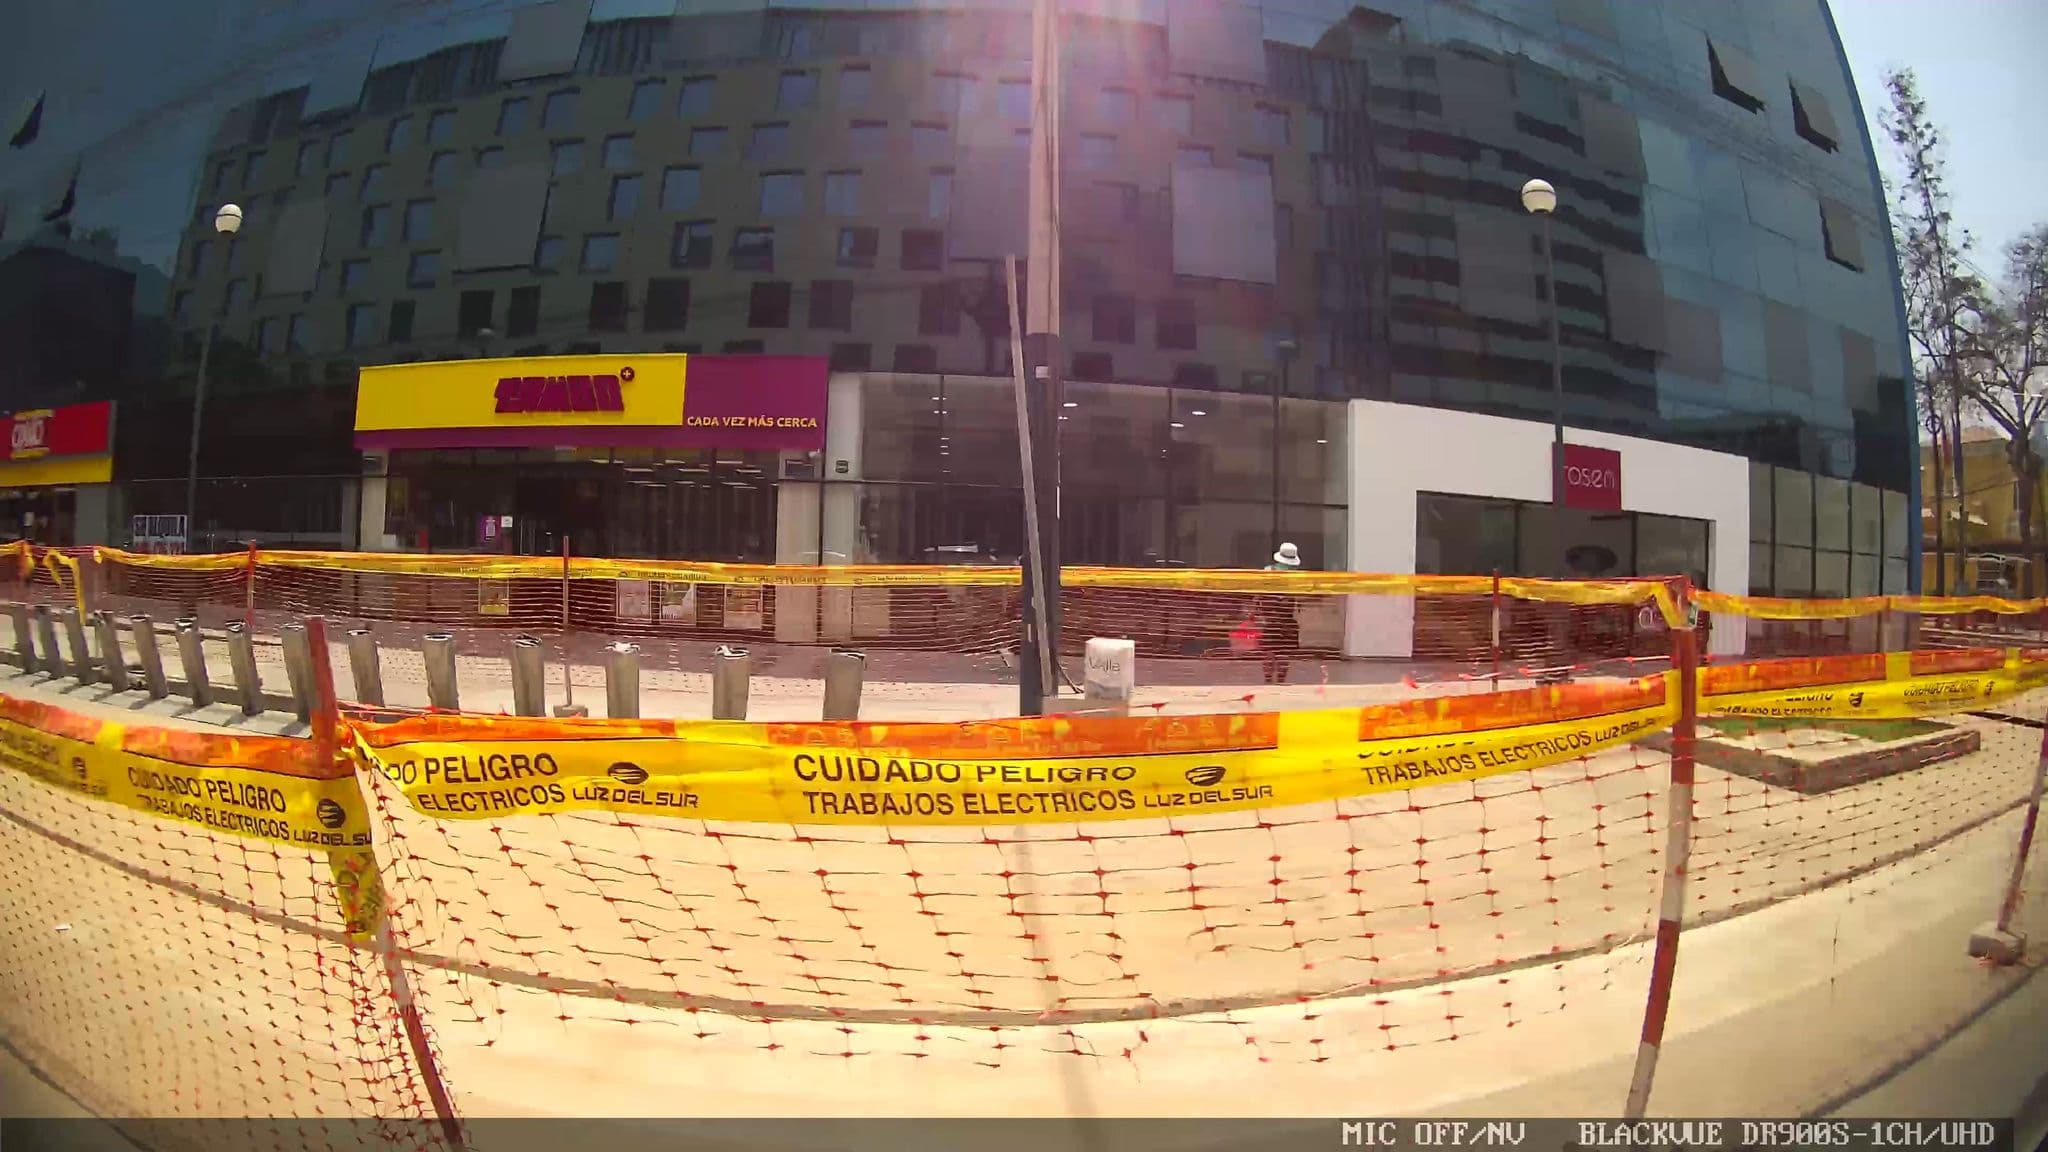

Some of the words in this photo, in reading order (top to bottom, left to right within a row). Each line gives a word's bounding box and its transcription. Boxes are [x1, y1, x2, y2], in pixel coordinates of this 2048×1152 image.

[687, 416, 720, 426] CADA
[722, 416, 746, 427] VEZ
[747, 415, 774, 427] MÁS
[776, 417, 818, 428] CERCA
[424, 752, 559, 784] PELIGRO
[793, 754, 961, 783] CUIDADO
[975, 765, 1137, 783] PELIGRO
[1361, 752, 1476, 787] TRABAJOS
[1482, 729, 1593, 768] ELECTRICOS
[127, 766, 202, 797] CUIDADO
[205, 778, 287, 814] PELIGRO
[417, 783, 566, 813] ELECTRICOS
[572, 786, 609, 801] LUZ
[611, 789, 653, 805] DEL
[655, 792, 700, 809] SUR
[803, 790, 954, 816] TRABAJOS
[962, 788, 1137, 815] ELECTRICOS
[1144, 792, 1186, 808] LUZ
[1188, 790, 1231, 805] DEL
[1232, 784, 1274, 800] SUR
[204, 806, 290, 842] ELECTRICOS
